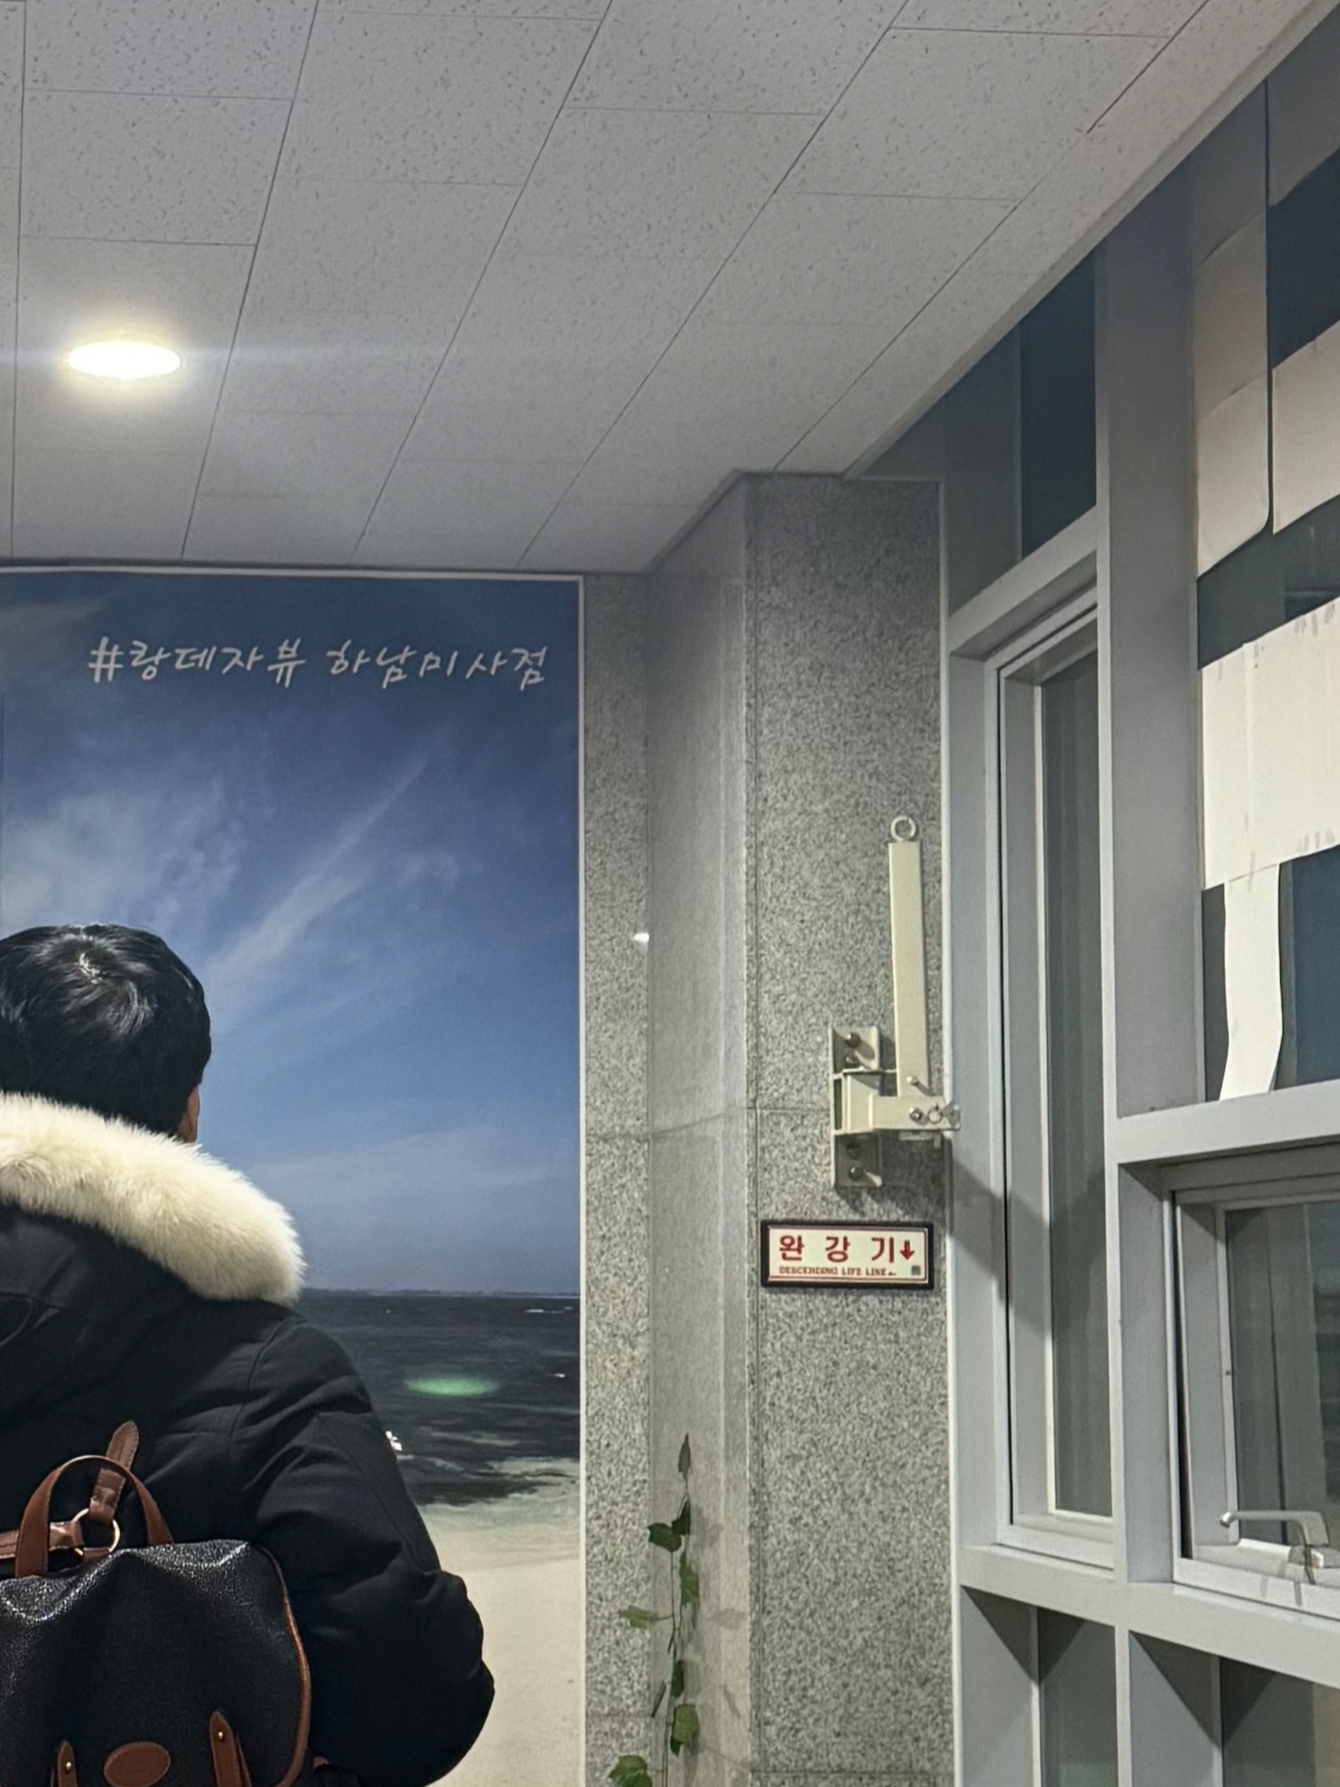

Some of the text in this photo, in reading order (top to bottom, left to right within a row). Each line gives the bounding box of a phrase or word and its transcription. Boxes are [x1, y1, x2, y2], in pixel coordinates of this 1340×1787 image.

[88, 636, 548, 690] #랑데자뷰 하남미사점
[841, 1267, 862, 1276] LIFE
[865, 1267, 887, 1276] LINE
